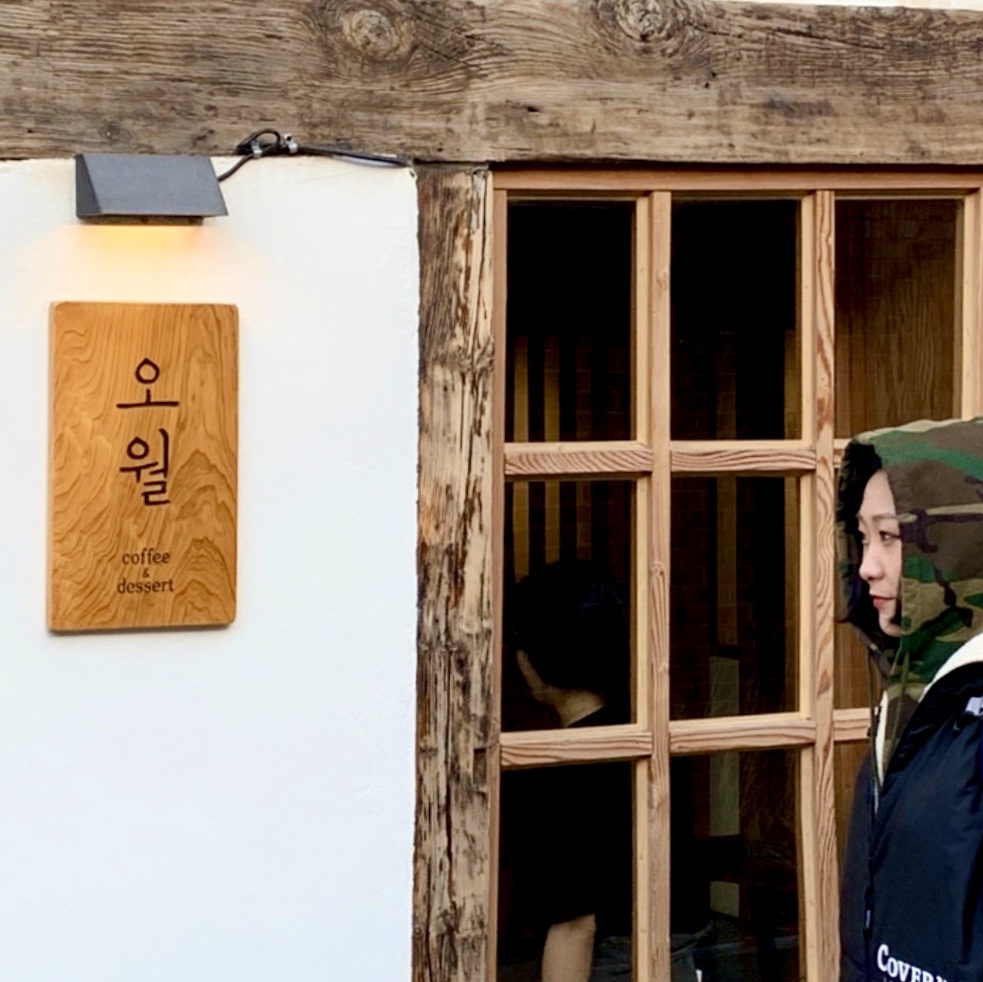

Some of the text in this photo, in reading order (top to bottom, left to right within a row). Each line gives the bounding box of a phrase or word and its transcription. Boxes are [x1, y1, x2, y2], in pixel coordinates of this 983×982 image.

[116, 358, 180, 505] 오월
[122, 547, 171, 565] coffee
[142, 567, 150, 578] &
[117, 577, 174, 594] dessert
